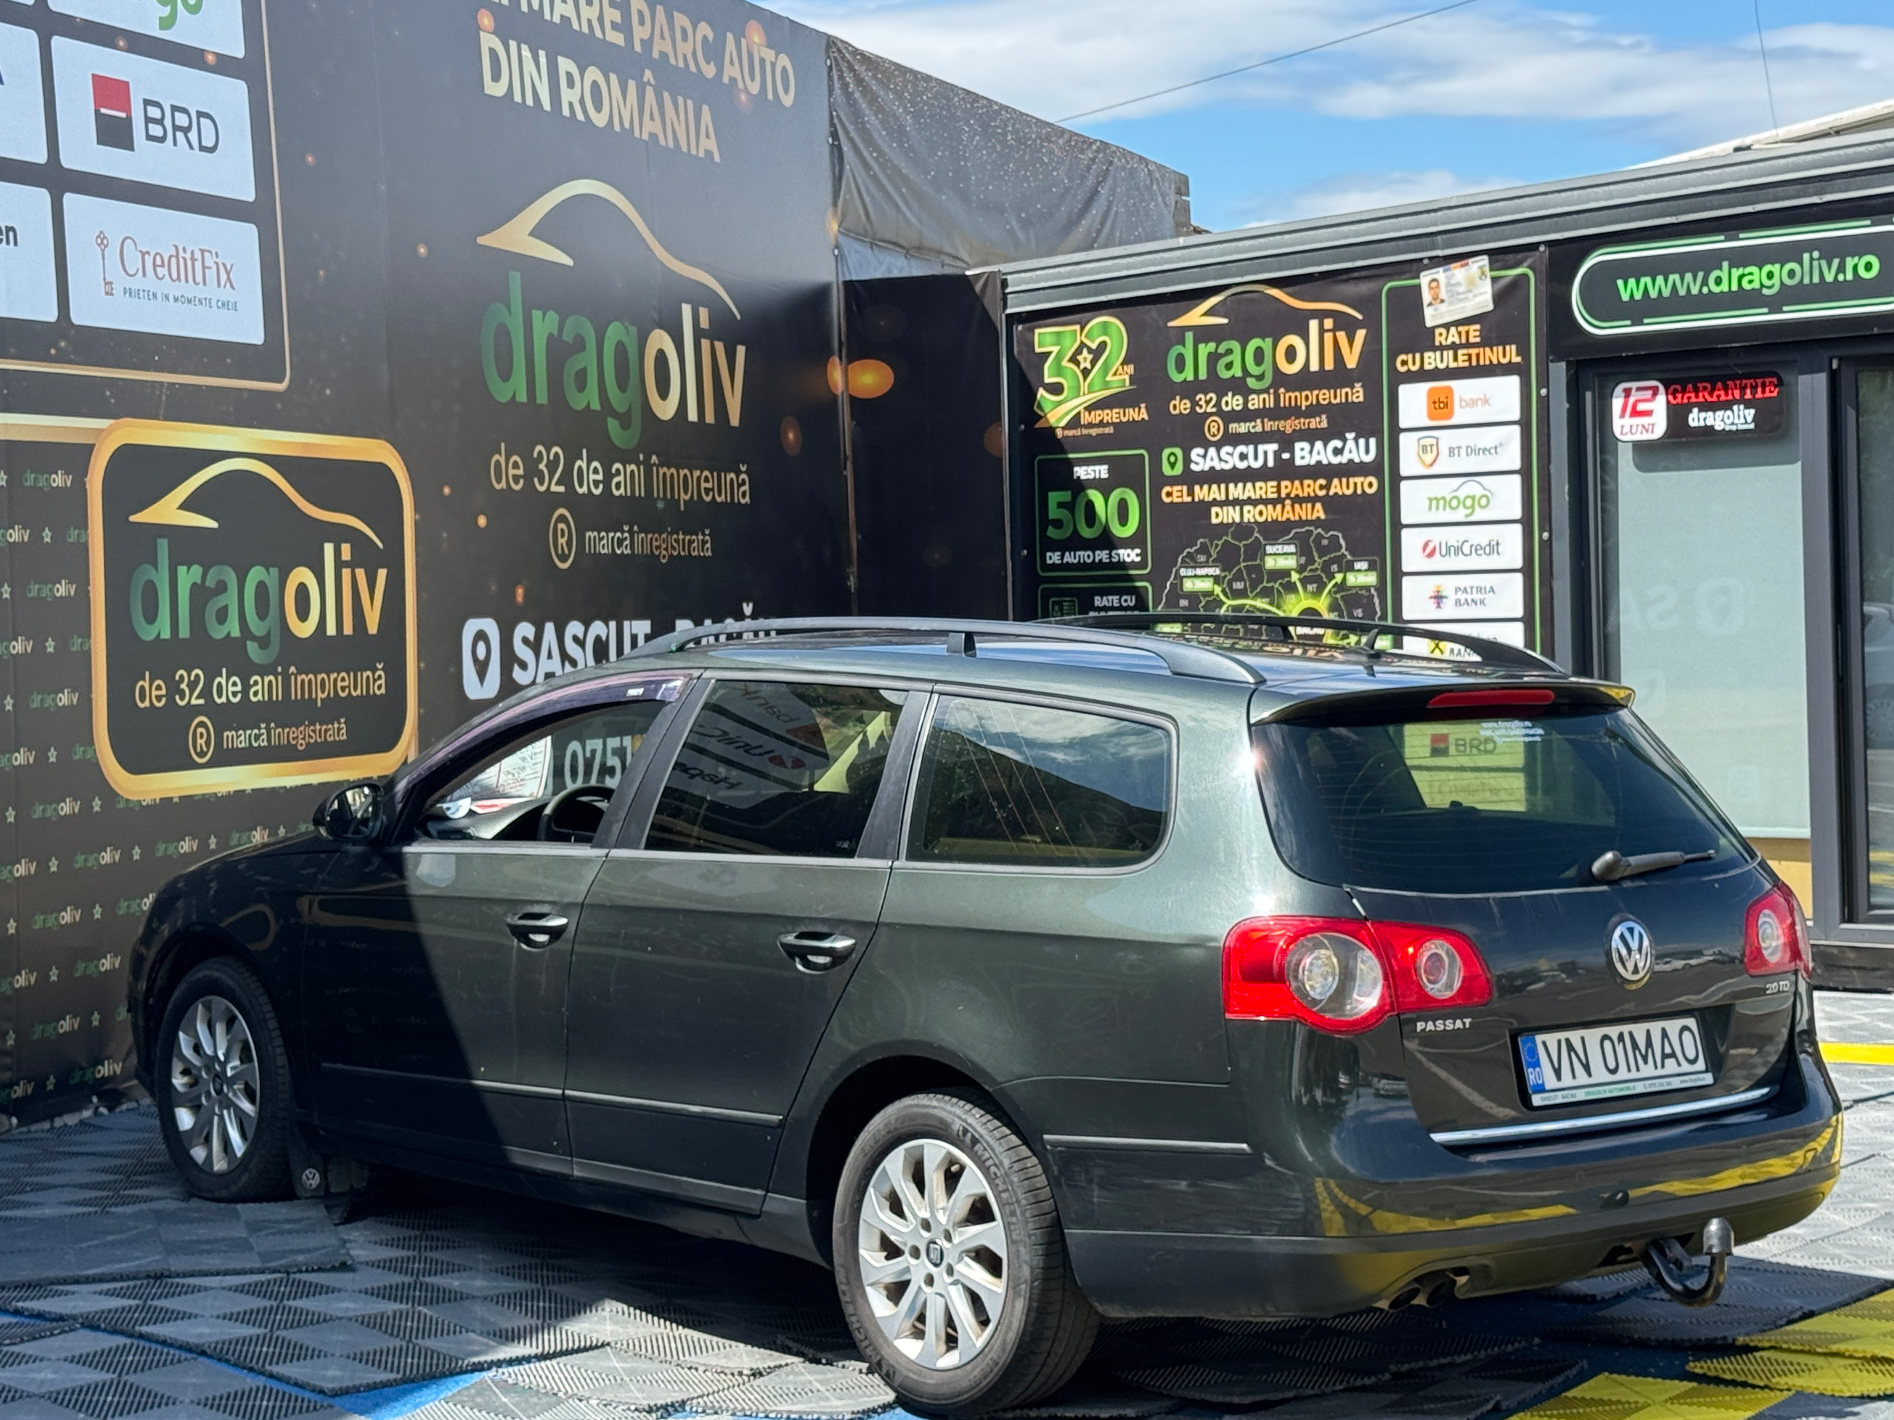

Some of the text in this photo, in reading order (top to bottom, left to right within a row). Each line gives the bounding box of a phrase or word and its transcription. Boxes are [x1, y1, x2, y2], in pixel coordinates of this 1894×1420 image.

[630, 0, 716, 78] PARC
[723, 32, 795, 107] AUTO
[480, 31, 720, 163] DIN ROMÂNIA
[142, 98, 220, 154] BRD
[119, 236, 236, 291] CreditFix
[1616, 250, 1881, 302] www.dragoliv.ro
[123, 287, 239, 312] PRIETEN IN MOMENTE CHEIE
[1434, 324, 1481, 346] RATE
[480, 271, 746, 449] dragoliv
[1034, 316, 1128, 417] 32
[1167, 318, 1367, 390] dragoliv
[1396, 344, 1522, 372] CU BULETINUL
[1169, 383, 1365, 415] de 32 de ani împreună
[1432, 395, 1491, 411] tbi bank
[1618, 386, 1659, 419] 12
[1667, 377, 1780, 405] GARANTIE
[1081, 403, 1149, 425] ÎMPREUNĂ
[1228, 418, 1262, 434] marcă
[1264, 415, 1328, 434] înregistrată
[1688, 404, 1756, 431] dragoliv
[1619, 422, 1656, 436] LUNI
[1190, 443, 1279, 472] SASCUT
[1294, 432, 1377, 467] BACĂU
[1421, 444, 1434, 454] BT
[1448, 447, 1461, 458] BT
[23, 470, 72, 491] dragoliv
[490, 442, 750, 510] de 32 de ani împreună
[1073, 465, 1109, 480] PESTE
[1161, 476, 1379, 504] CEL MAI MARE PARC AUTO
[1046, 487, 1140, 540] 500
[1210, 500, 1326, 524] DIN ROMÂNIA
[1427, 493, 1490, 518] mogo
[585, 526, 631, 555] marcă
[634, 527, 712, 563] înregistrată
[1046, 548, 1142, 564] DE AUTO PE STOC
[1439, 539, 1501, 558] UniCredit
[27, 579, 76, 600] dragoliv
[129, 538, 388, 665] dragoliv
[1094, 595, 1136, 607] RATE CU
[1454, 585, 1496, 596] PATRIA
[1454, 597, 1487, 608] BANK
[135, 662, 386, 708] de 32 de ani împreună
[29, 688, 79, 709] dragoliv
[223, 723, 268, 750] marcă
[271, 717, 347, 749] înregistrată
[31, 797, 80, 819] dragoliv
[32, 906, 82, 930] dragoliv
[1416, 1018, 1472, 1032] PASSAT
[1528, 1024, 1700, 1085] RO VN 01MAO
